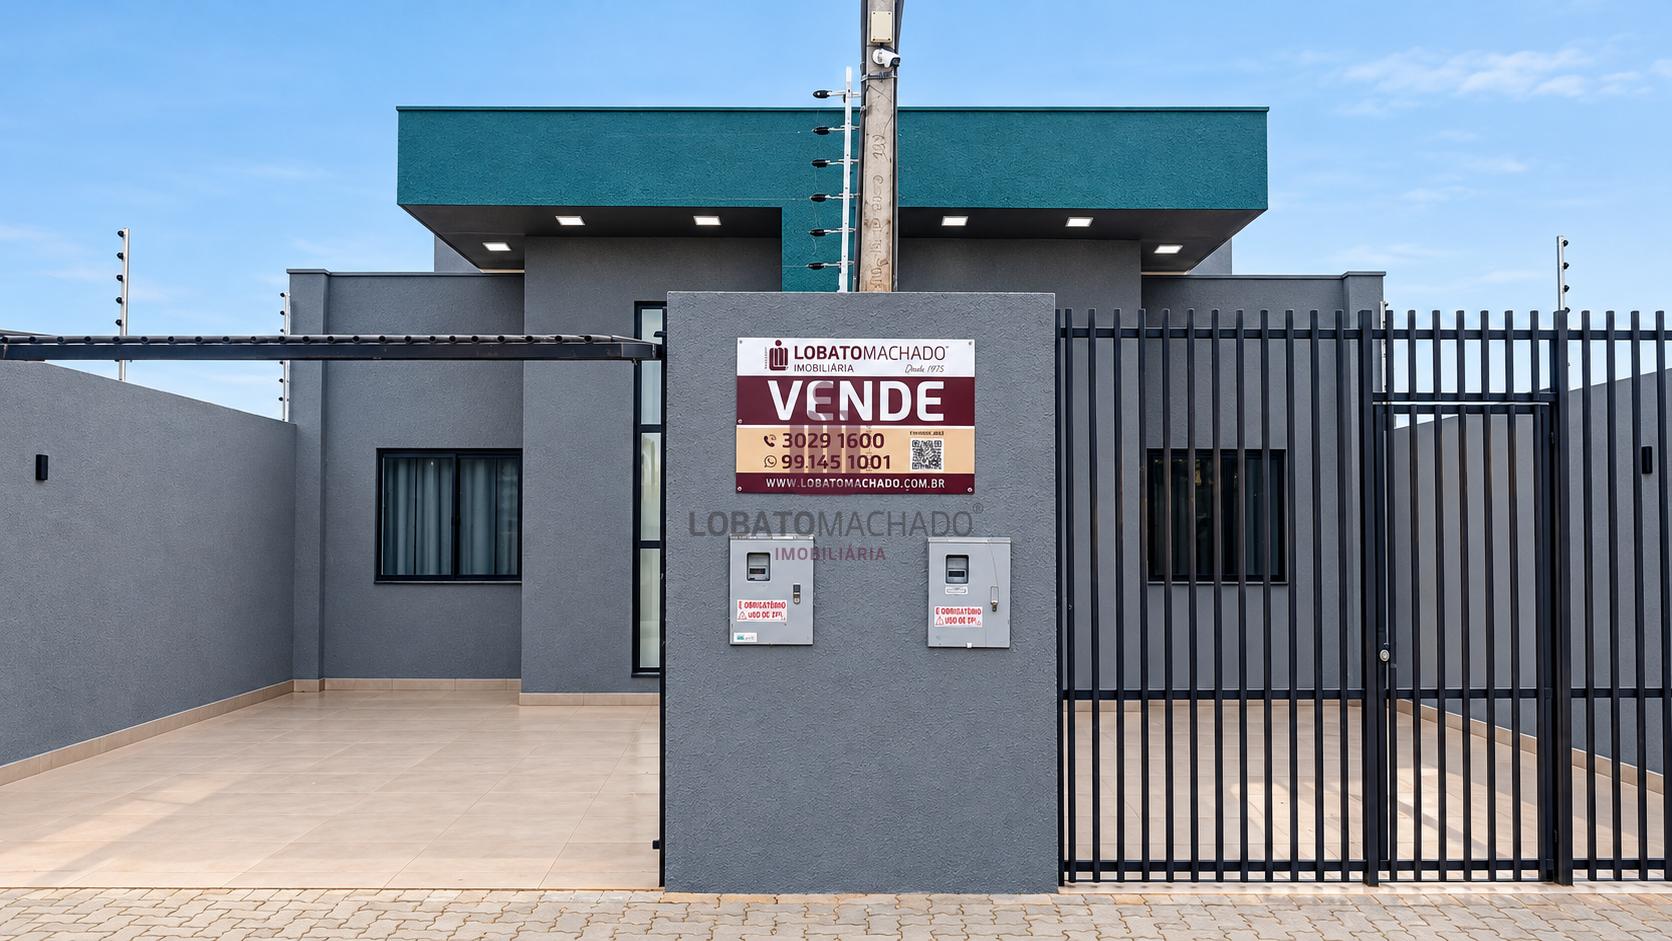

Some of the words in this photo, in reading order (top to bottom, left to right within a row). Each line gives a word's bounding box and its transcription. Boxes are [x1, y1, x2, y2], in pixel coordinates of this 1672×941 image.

[794, 345, 946, 361] LOBATOMACHADO
[794, 362, 854, 373] IMOBILIÁRIA
[927, 365, 945, 373] 1975
[767, 380, 945, 422] VENDE
[782, 432, 831, 449] 3029
[839, 432, 885, 449] 1600
[781, 454, 841, 470] 99.145
[849, 454, 891, 470] 1001
[766, 477, 946, 489] WWW.LOBATOMACHADO.COM.BR
